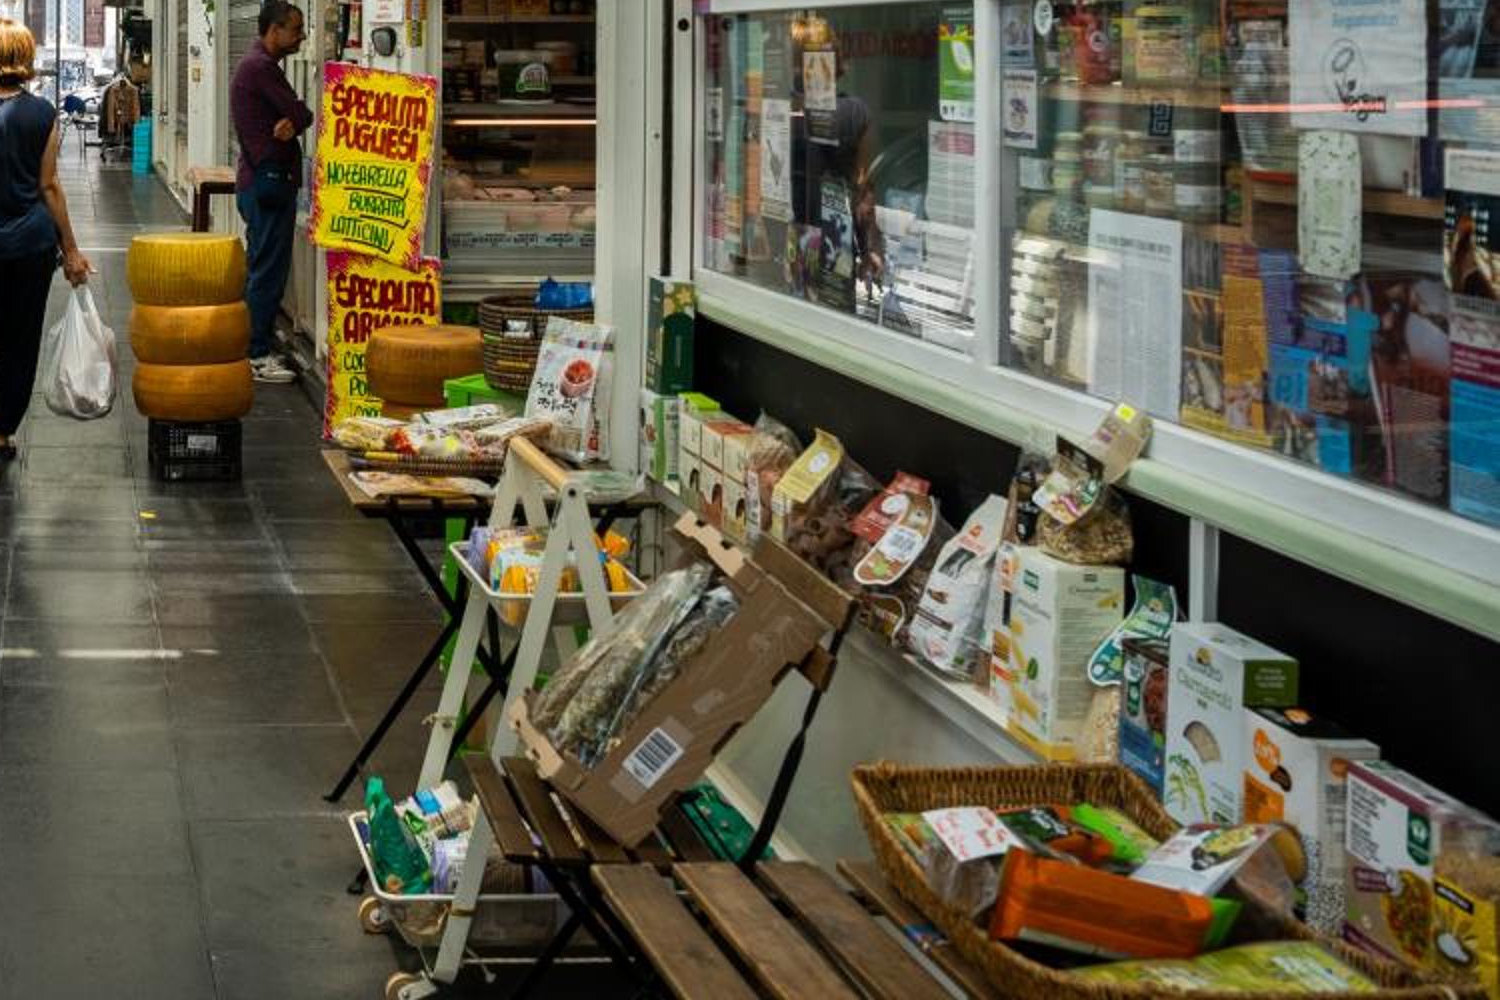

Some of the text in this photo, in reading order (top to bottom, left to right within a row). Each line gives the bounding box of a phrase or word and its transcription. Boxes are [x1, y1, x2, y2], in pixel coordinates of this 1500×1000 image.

[334, 117, 420, 162] PUGLIESI
[349, 190, 406, 219] BURRATA
[330, 215, 389, 248] LATTICINI
